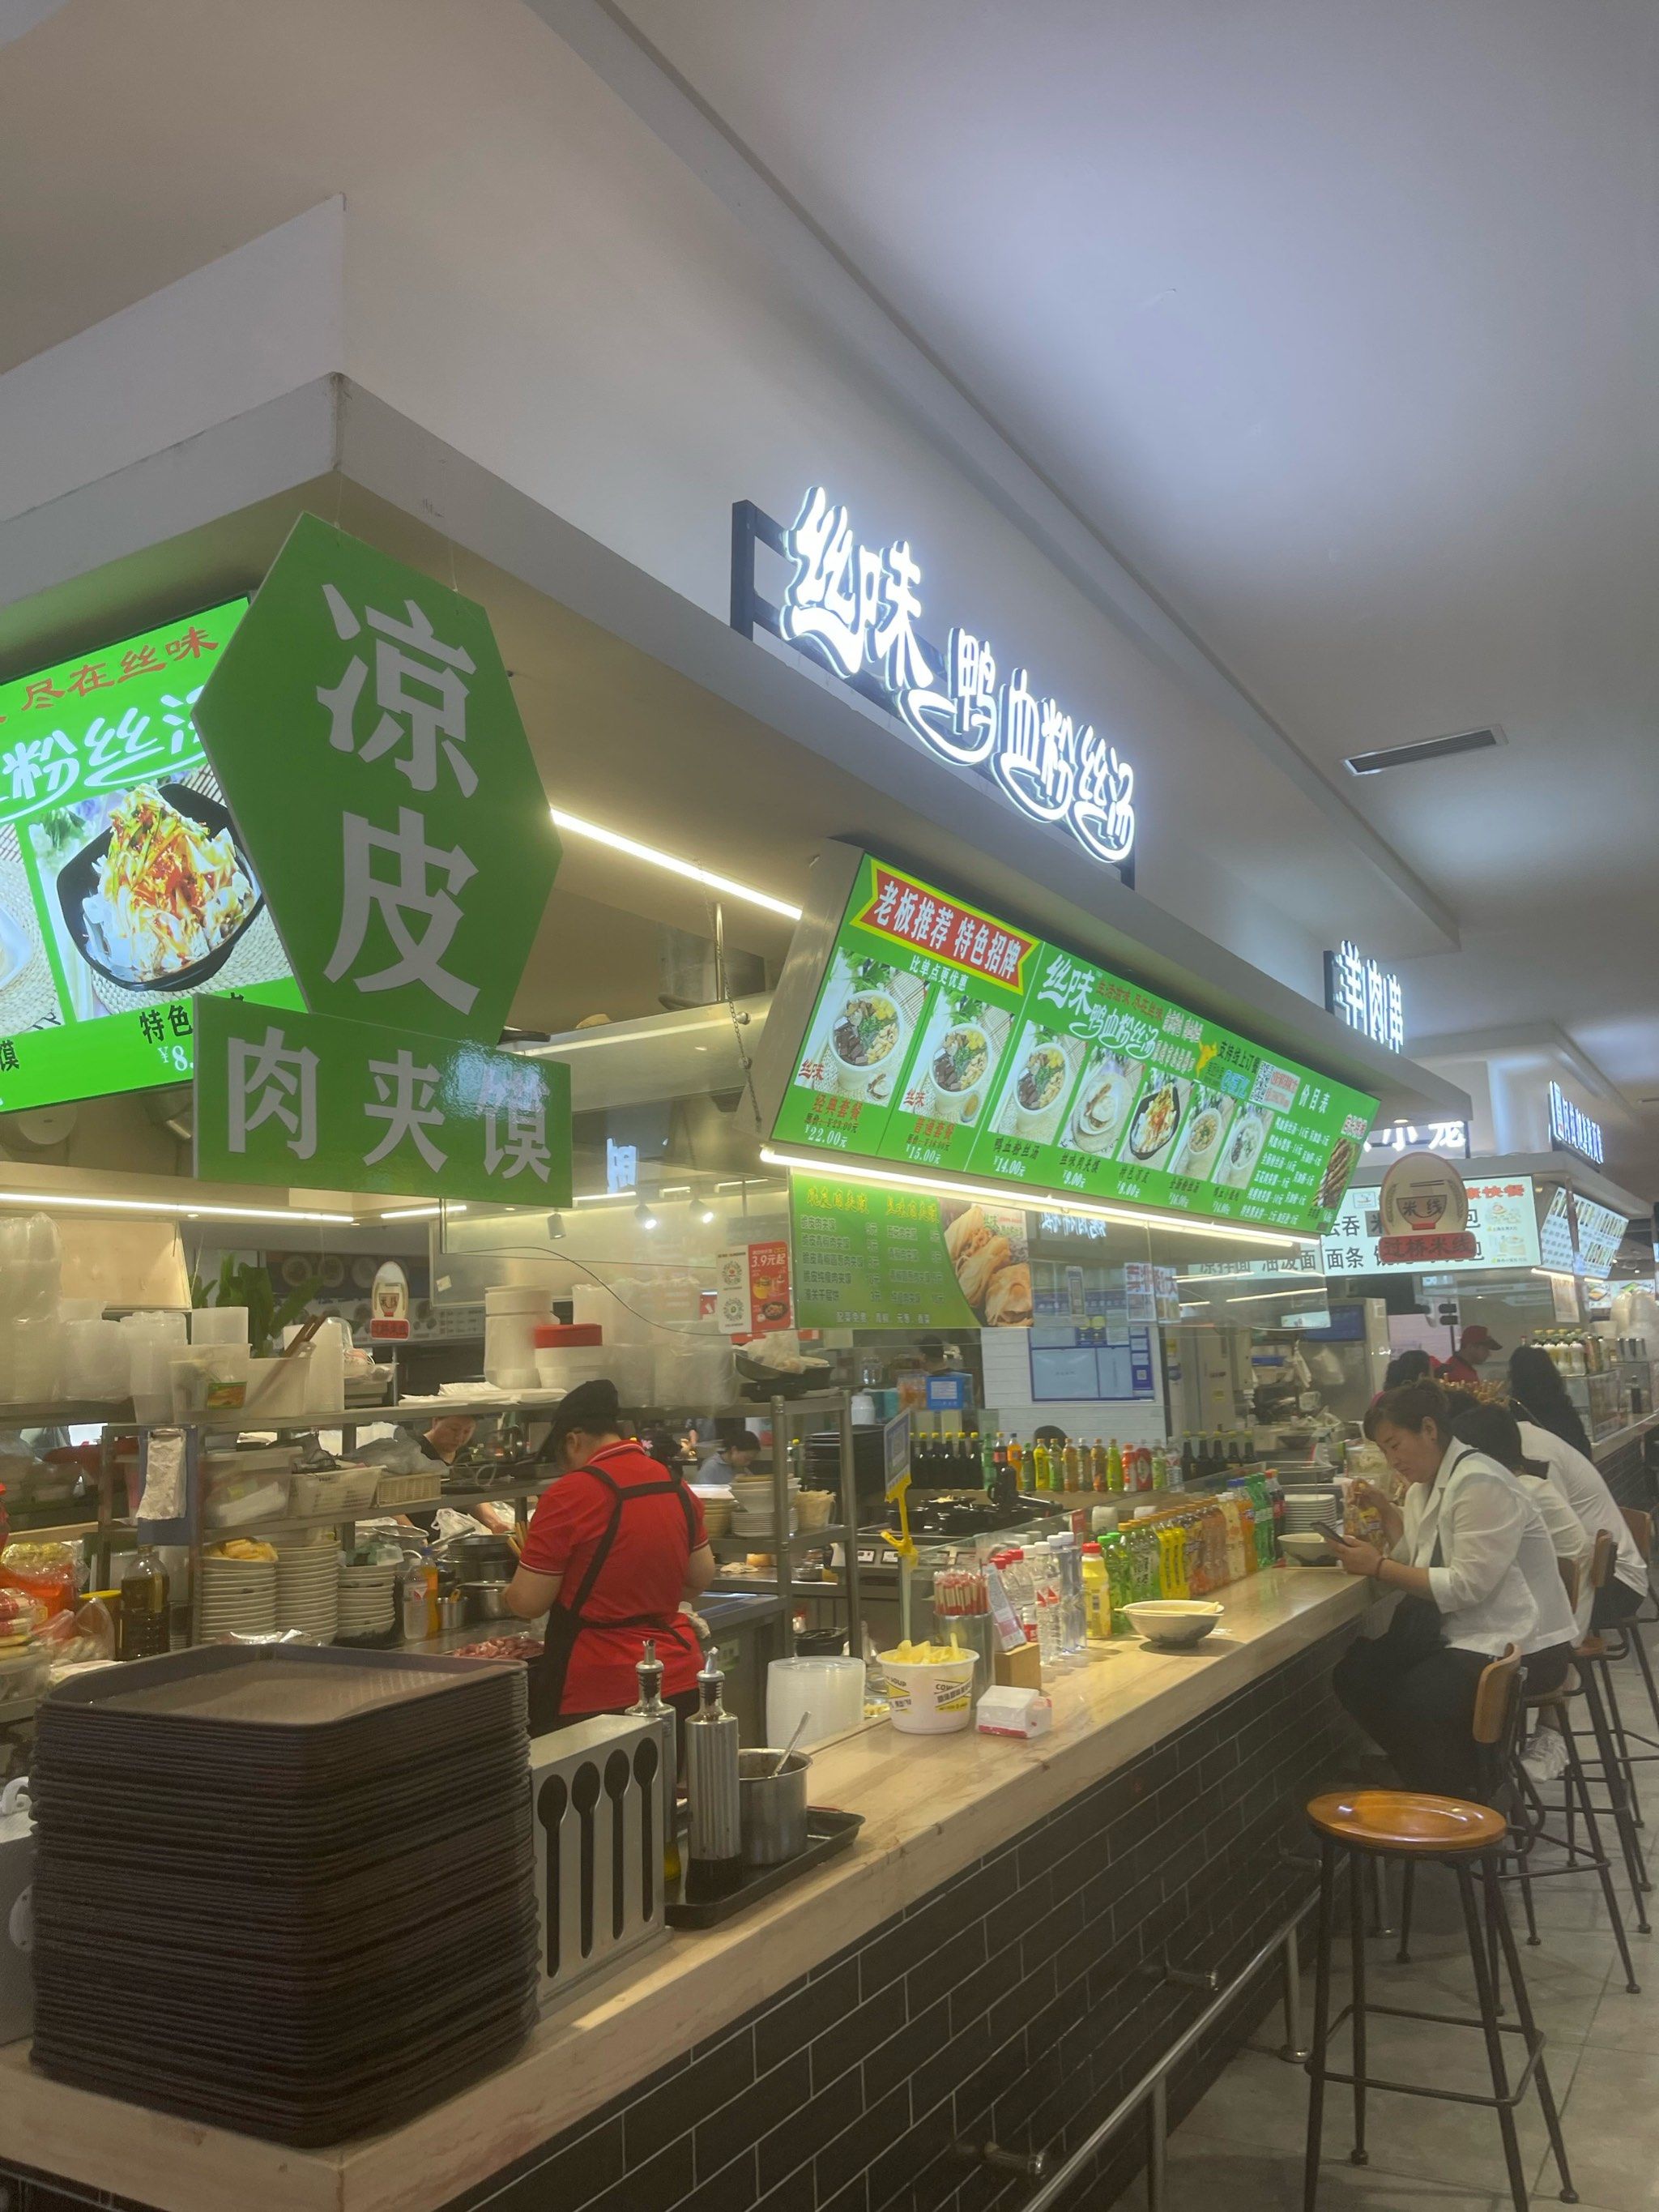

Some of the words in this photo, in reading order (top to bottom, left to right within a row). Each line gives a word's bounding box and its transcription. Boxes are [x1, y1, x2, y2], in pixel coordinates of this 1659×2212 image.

[780, 486, 933, 690] 丝味
[22, 626, 219, 711] 尽在丝味
[898, 628, 1134, 863] 鸭血粉丝汤
[316, 583, 480, 1016] 凉皮
[874, 880, 954, 950] 老板推荐
[953, 916, 1021, 980] 特色招牌
[909, 954, 969, 992] 比单点更优惠
[1037, 954, 1095, 1016] 丝味
[1331, 940, 1404, 1054] 羊肉串
[1068, 1003, 1159, 1060] 鸭血粉丝汤
[228, 1027, 552, 1185] 肉夹馍
[812, 1094, 863, 1121] 经典套餐
[1299, 1084, 1331, 1114] 价目表
[914, 1117, 957, 1141] 普通套餐
[993, 1136, 1040, 1160] 鸭血粉丝汤
[1363, 1121, 1466, 1152] 小龙
[1402, 1199, 1446, 1217] 米线
[751, 1253, 787, 1268] 3.9元起
[1325, 1246, 1364, 1270] 面条
[1384, 1236, 1471, 1258] 过桥米线
